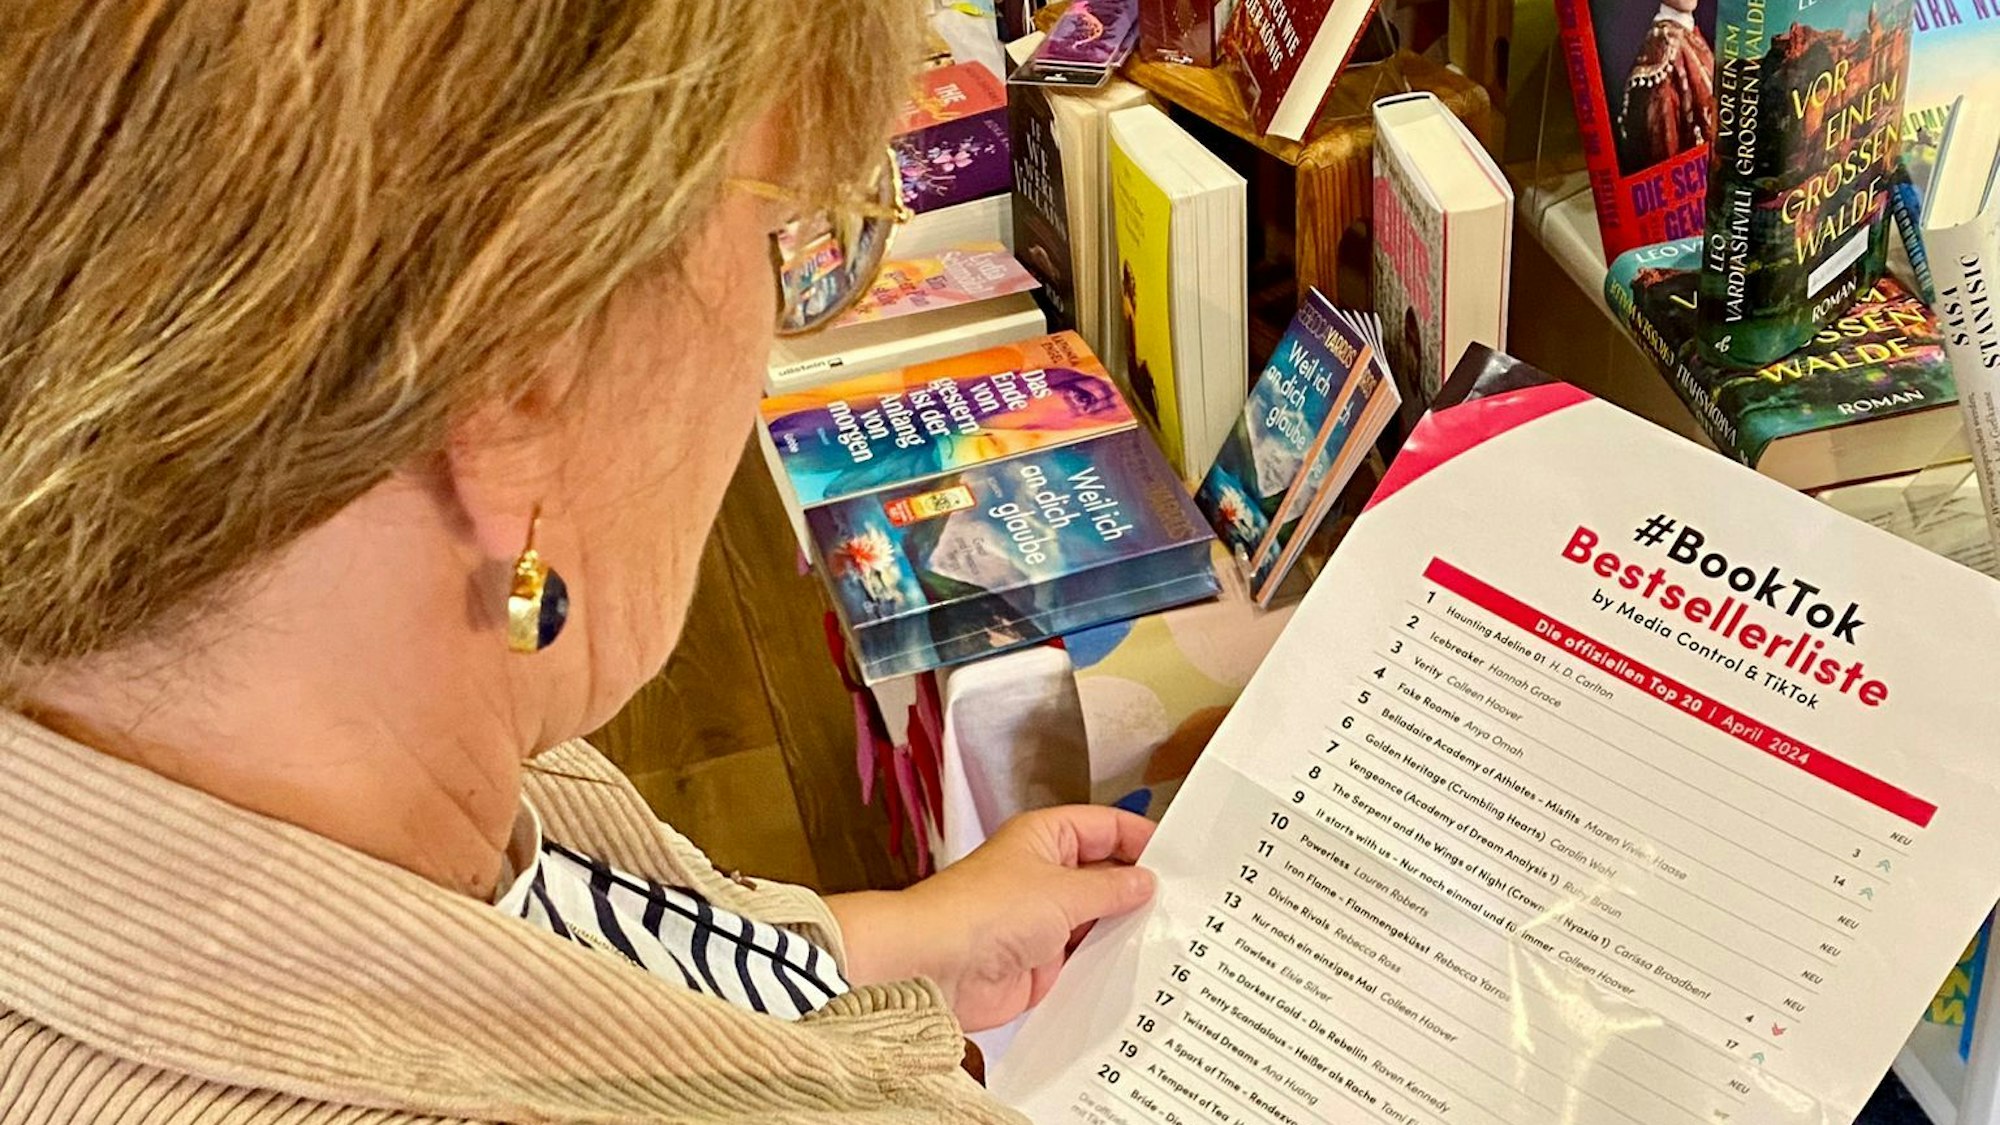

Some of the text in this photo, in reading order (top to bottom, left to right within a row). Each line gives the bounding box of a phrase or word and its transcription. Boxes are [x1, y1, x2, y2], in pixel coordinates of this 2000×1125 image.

[1259, 22, 1284, 71] KÖNIG
[1282, 19, 1301, 57] WIE
[1717, 23, 1741, 138] VOR EINEM
[1791, 58, 1850, 121] VOR
[1825, 72, 1900, 152] EINEM
[1735, 77, 1761, 176] GROSSEN
[1631, 173, 1669, 218] DIE
[1781, 121, 1903, 225] GROSSEN
[1796, 175, 1882, 266] WALDE
[1635, 245, 1678, 263] LEO
[1709, 233, 1727, 272] LEO
[1725, 190, 1753, 323] VARDIASHVILI
[1811, 275, 1858, 324] ROMAN
[1020, 369, 1053, 400] Das
[1266, 365, 1308, 410] an dich
[1288, 340, 1333, 398] Weil ich
[1757, 335, 1913, 384] WALDE
[880, 393, 926, 449] Anfang
[908, 389, 950, 436] ist der
[928, 377, 980, 434] gestern
[969, 382, 1000, 413] von
[990, 371, 1029, 412] Ende
[1838, 388, 1926, 416] ROMAN
[827, 400, 874, 463] morgen
[860, 409, 890, 440] von
[1265, 405, 1307, 450] glaube
[1020, 465, 1081, 529] an dich
[1067, 466, 1133, 542] Weil ich
[988, 502, 1052, 565] glaube
[1633, 514, 1866, 646] #BookTok
[1426, 591, 1613, 699] 1 Haunting Adeline Carlton
[1561, 525, 1889, 707] Bestsellerliste
[1390, 640, 1442, 679] 3 Verity
[1406, 615, 1528, 690] 2 Icebreaker Hannah
[1591, 588, 1819, 710] by Media Control TikTok
[1373, 667, 1460, 722] 4 Fake Roomie
[1535, 618, 1811, 765] Die offiziellen Top 20 April 2024
[1341, 715, 1545, 841] 6 Golden Heritage (Crumbling Hearts)
[1357, 690, 1579, 824] 5 Belladaire Academy Athletes Misfits
[1325, 739, 1547, 877] 7 Vengeance (Academy Dream Analysis
[1890, 831, 1912, 847] NEU
[1270, 812, 1349, 869] 10 Powerless
[1292, 790, 1554, 952] 9 starts with Nur noch einmal und immer
[1308, 765, 1599, 941] 8 The Serpent and the Wings Night Nyaxia
[1240, 864, 1329, 930] 12 Divine Rivals
[1257, 840, 1430, 953] 11 Iron Flame Flammengeküsst
[1837, 915, 1860, 931] NEU
[1205, 915, 1275, 968] 14 Flawless
[1224, 891, 1377, 993] 13 Nur noch ein einziges Mal
[1819, 942, 1842, 958] NEU
[1189, 940, 1367, 1062] 15 The Darkest Gold Die Rebellin
[1783, 997, 1806, 1013] NEU
[1801, 970, 1823, 986] NEU
[1136, 1014, 1240, 1091] 18 Spark Time
[1155, 989, 1258, 1066] 17 Twisted Dreams
[1171, 964, 1376, 1104] 16 Pretty Scandalous Heißer als Rache
[1097, 1063, 1157, 1111] 20 Bride
[1119, 1040, 1229, 1121] 19 Tempest Tea
[1728, 1078, 1751, 1096] NEU
